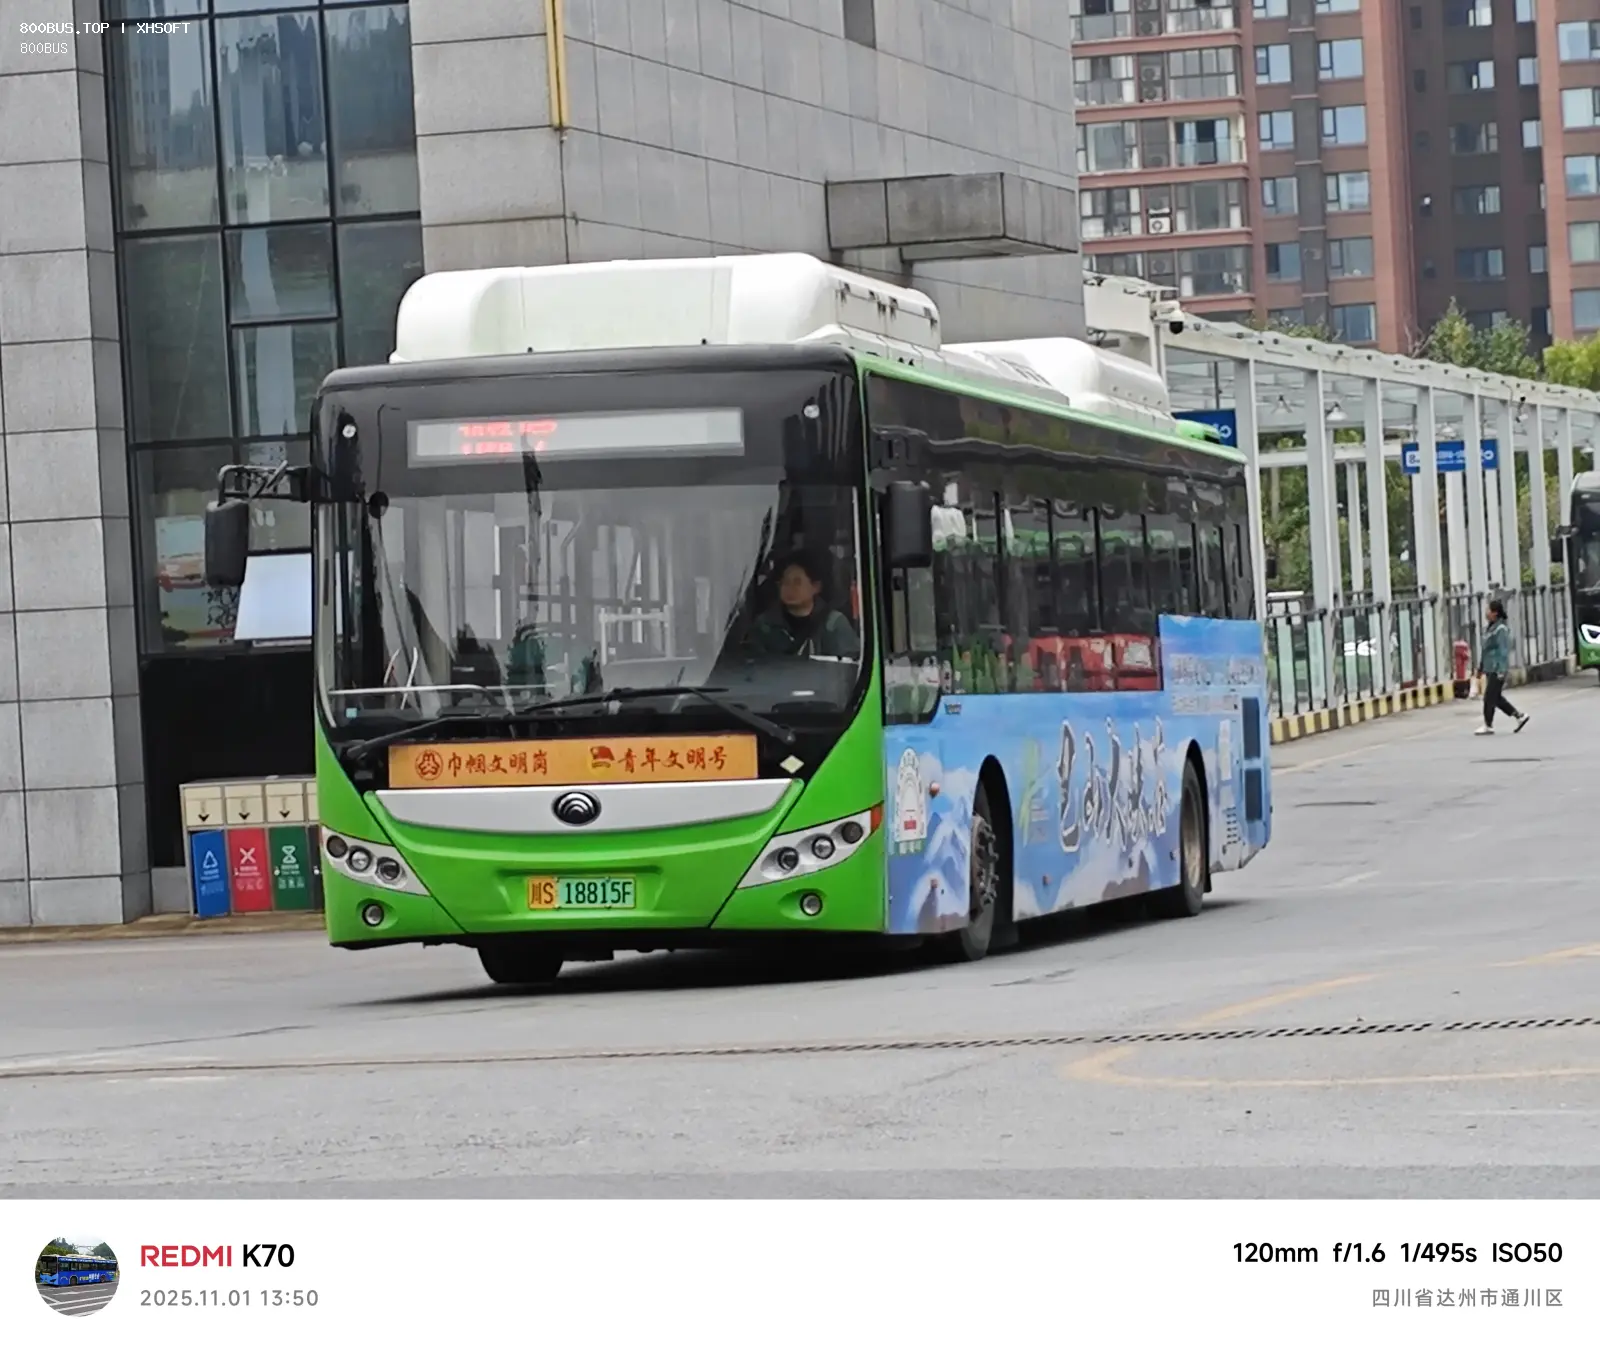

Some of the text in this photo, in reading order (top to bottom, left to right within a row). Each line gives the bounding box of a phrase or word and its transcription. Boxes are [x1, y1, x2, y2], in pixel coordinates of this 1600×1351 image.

[447, 750, 549, 776] 巾帼文明岗
[617, 745, 728, 774] 青年文明号
